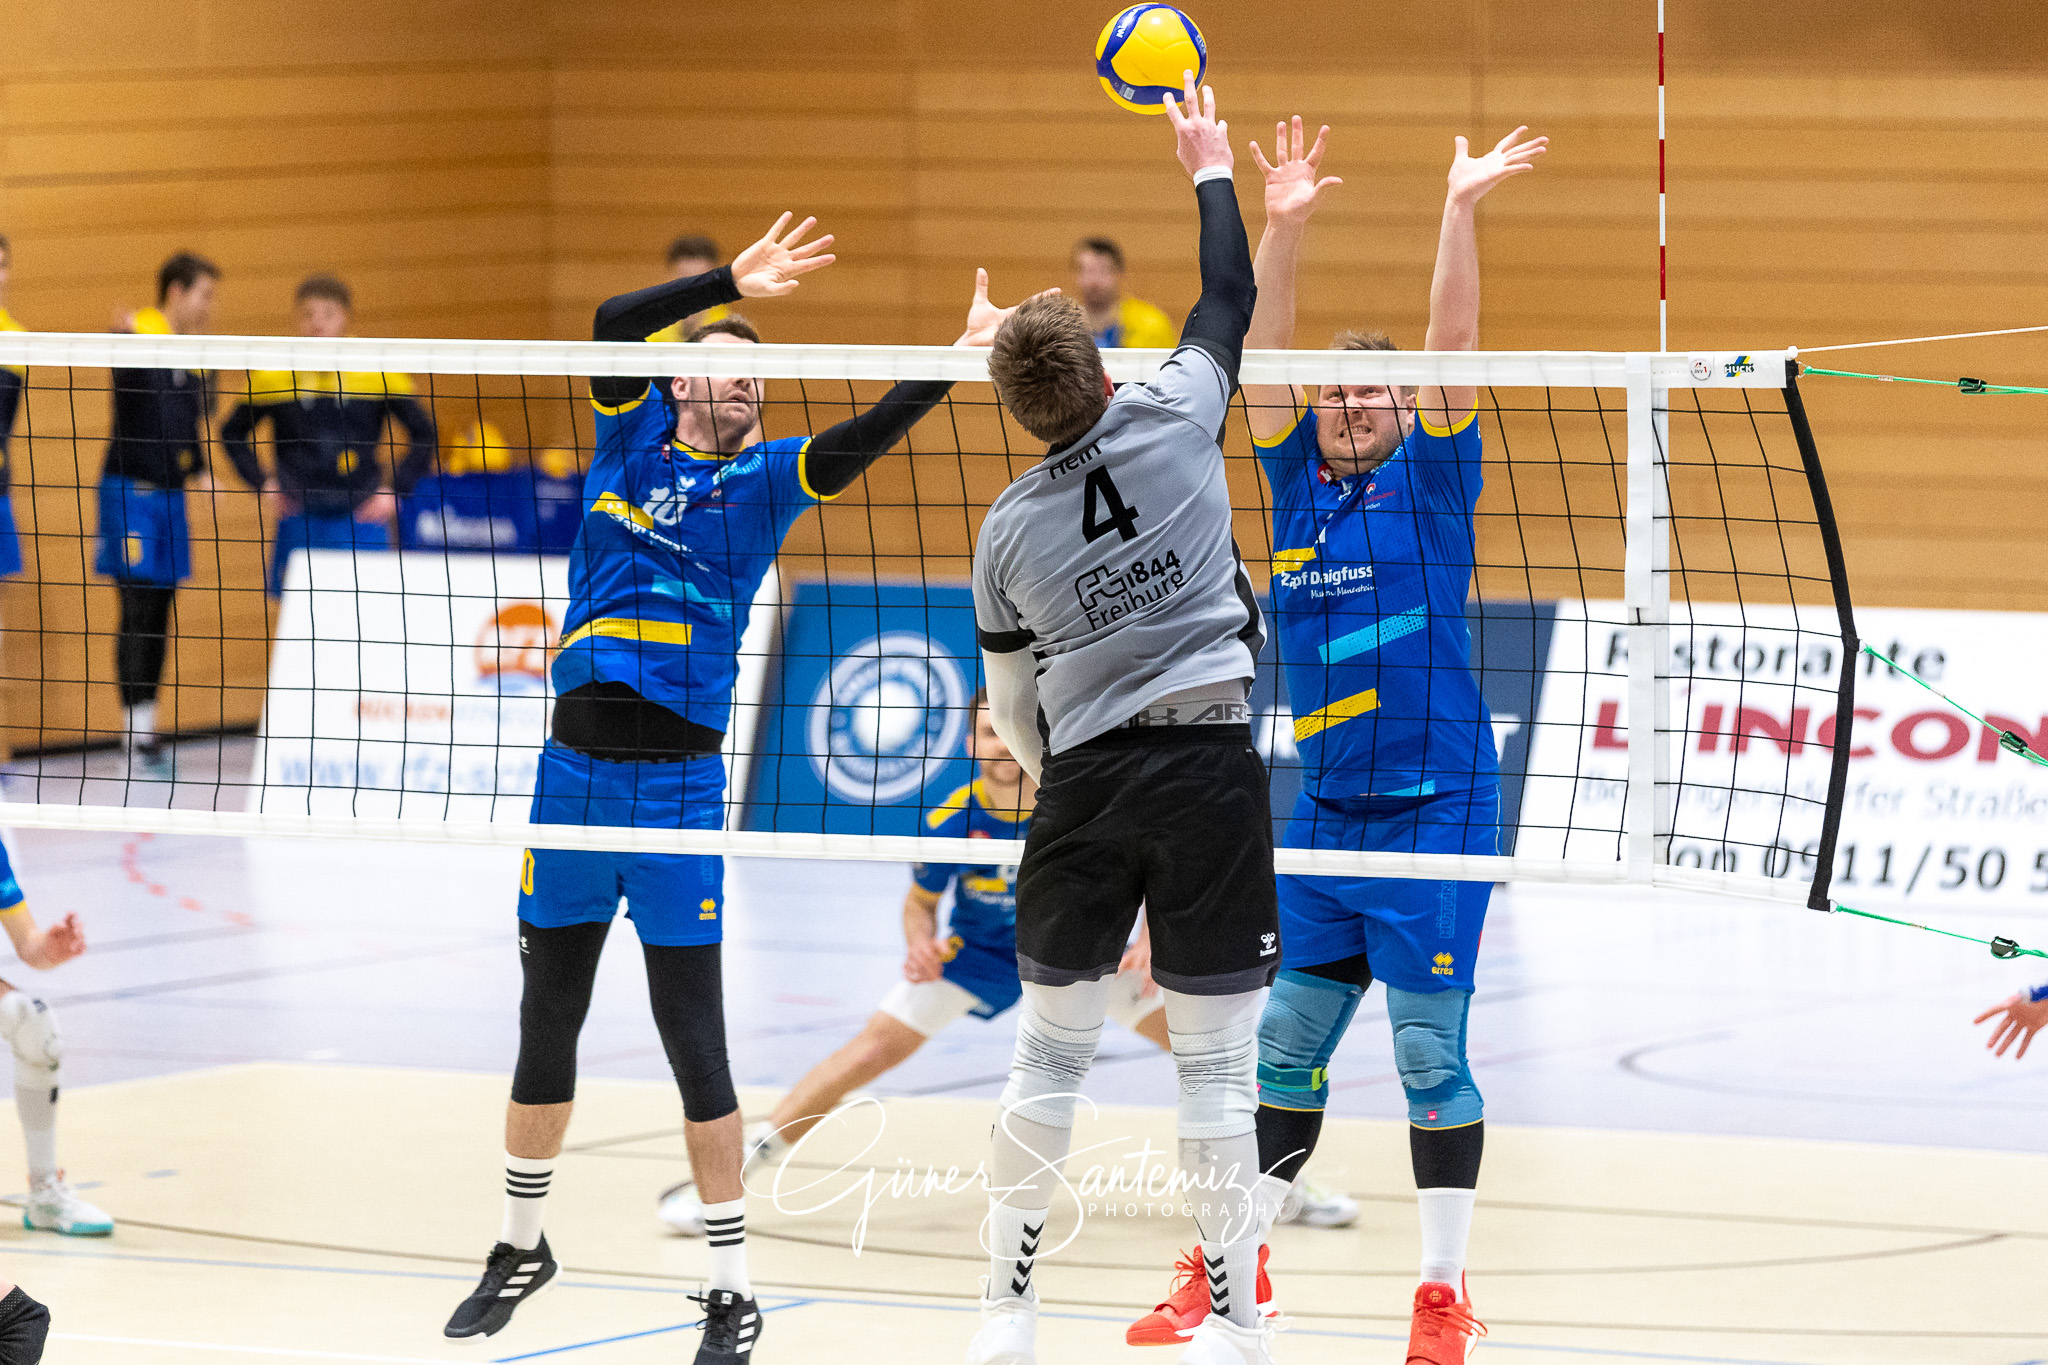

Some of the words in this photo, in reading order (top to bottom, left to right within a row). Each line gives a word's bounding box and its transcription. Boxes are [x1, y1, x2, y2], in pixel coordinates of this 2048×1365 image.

[1724, 365, 1752, 373] HUCK
[642, 487, 688, 526] 10
[1082, 465, 1139, 544] 4
[1126, 549, 1180, 588] 1844
[1310, 566, 1373, 585] Daigfuss
[1086, 570, 1186, 631] Freiburg
[1606, 630, 1946, 679] Rstorate
[1189, 703, 1248, 724] AR
